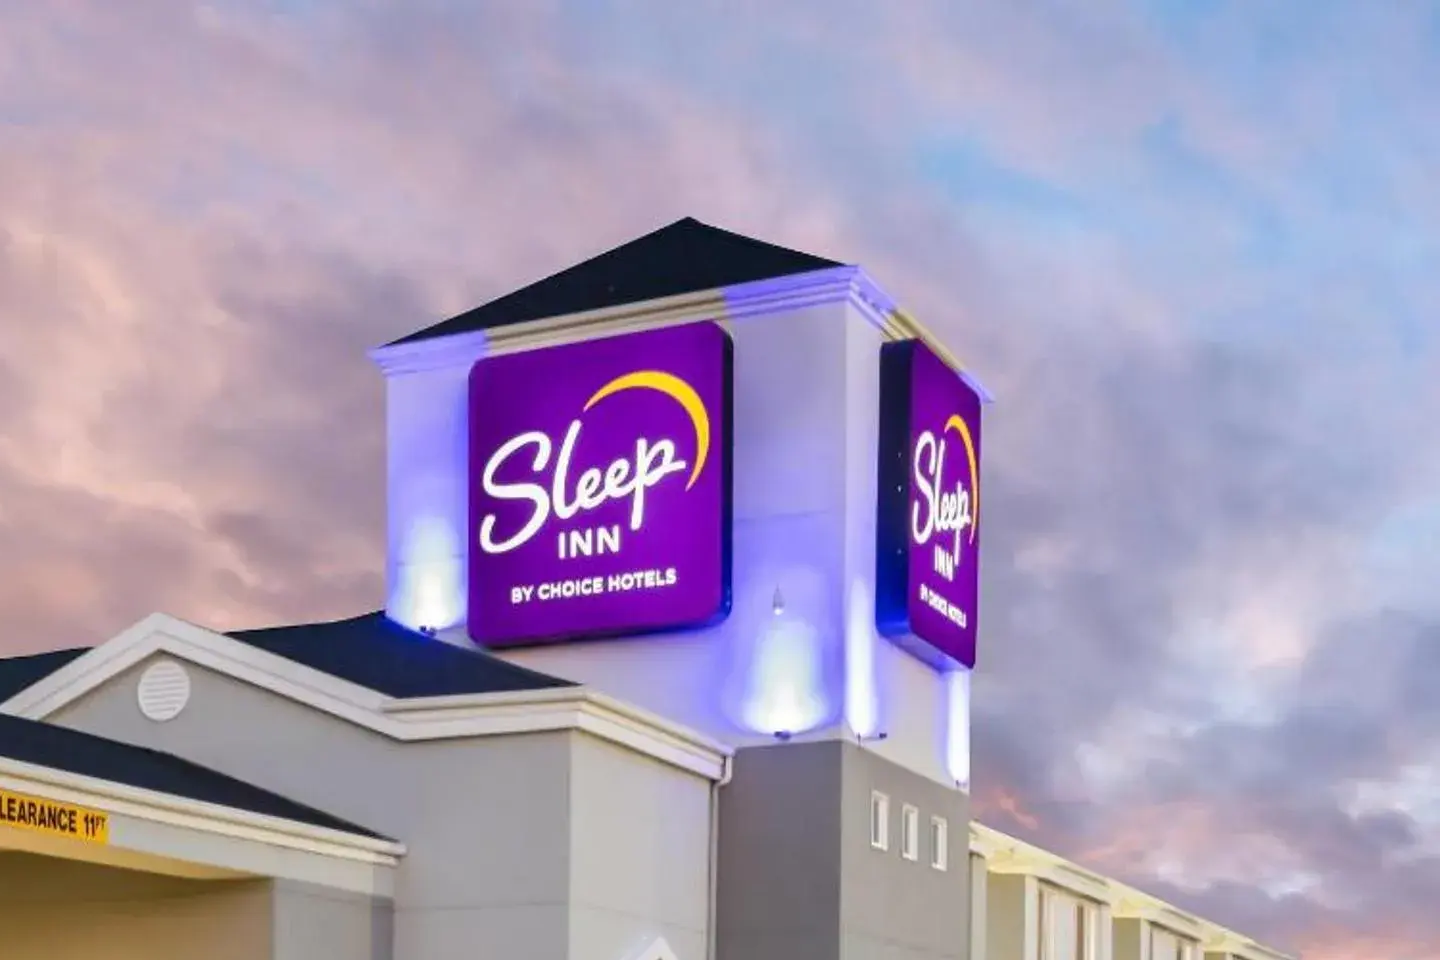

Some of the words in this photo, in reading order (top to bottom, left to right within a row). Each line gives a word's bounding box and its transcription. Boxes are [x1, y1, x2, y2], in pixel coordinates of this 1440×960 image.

[479, 419, 687, 554] Sleep
[912, 430, 972, 566] Sleep
[511, 587, 536, 604] BY
[538, 576, 604, 600] CHOICE
[608, 567, 678, 592] HOTELS
[558, 525, 621, 560] INN
